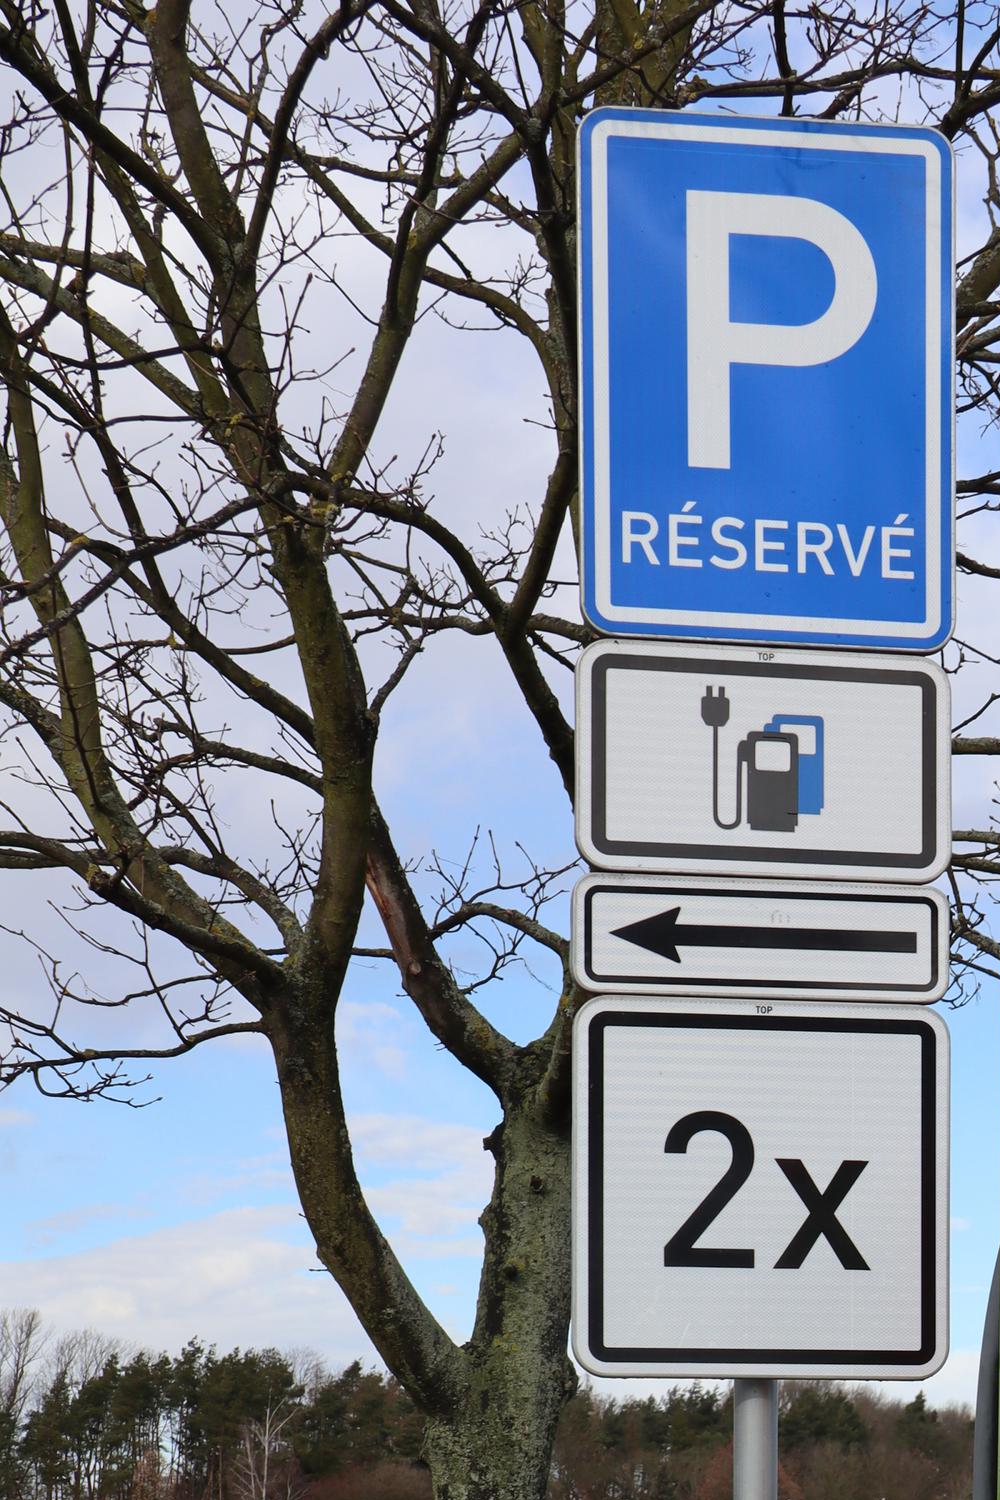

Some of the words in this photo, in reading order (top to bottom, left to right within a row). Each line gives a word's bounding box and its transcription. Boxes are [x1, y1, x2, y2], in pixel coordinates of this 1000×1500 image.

[685, 189, 878, 470] P
[621, 500, 915, 580] RÉSERVÉ
[757, 652, 775, 661] TOP
[756, 1006, 773, 1014] TOP
[663, 1109, 871, 1271] 2x
